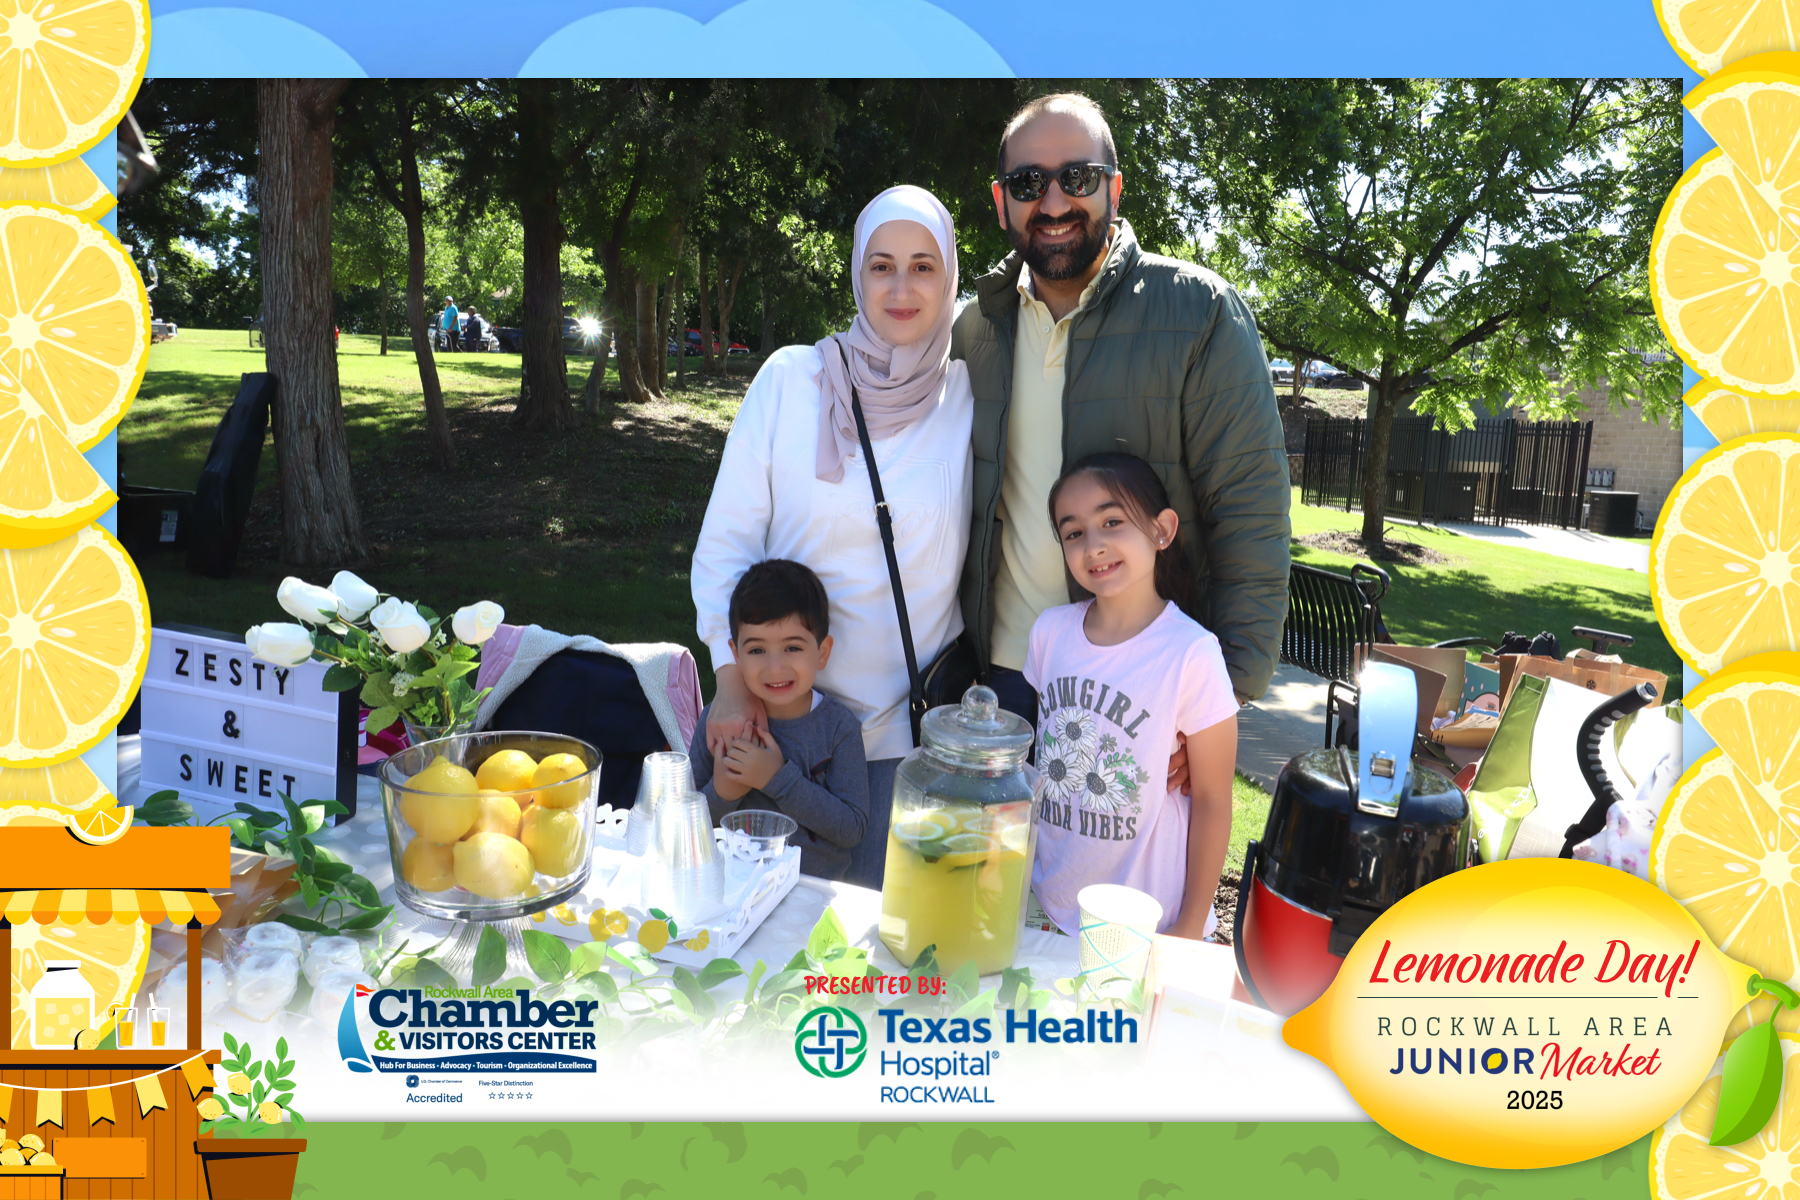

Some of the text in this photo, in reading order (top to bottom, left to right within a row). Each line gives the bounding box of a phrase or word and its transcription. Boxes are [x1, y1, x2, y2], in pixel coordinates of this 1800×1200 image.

[175, 648, 290, 696] ZESTY
[222, 710, 240, 739] &
[1039, 676, 1151, 740] COWGIRL
[179, 753, 296, 799] SWEET
[1079, 808, 1137, 841] VIBES
